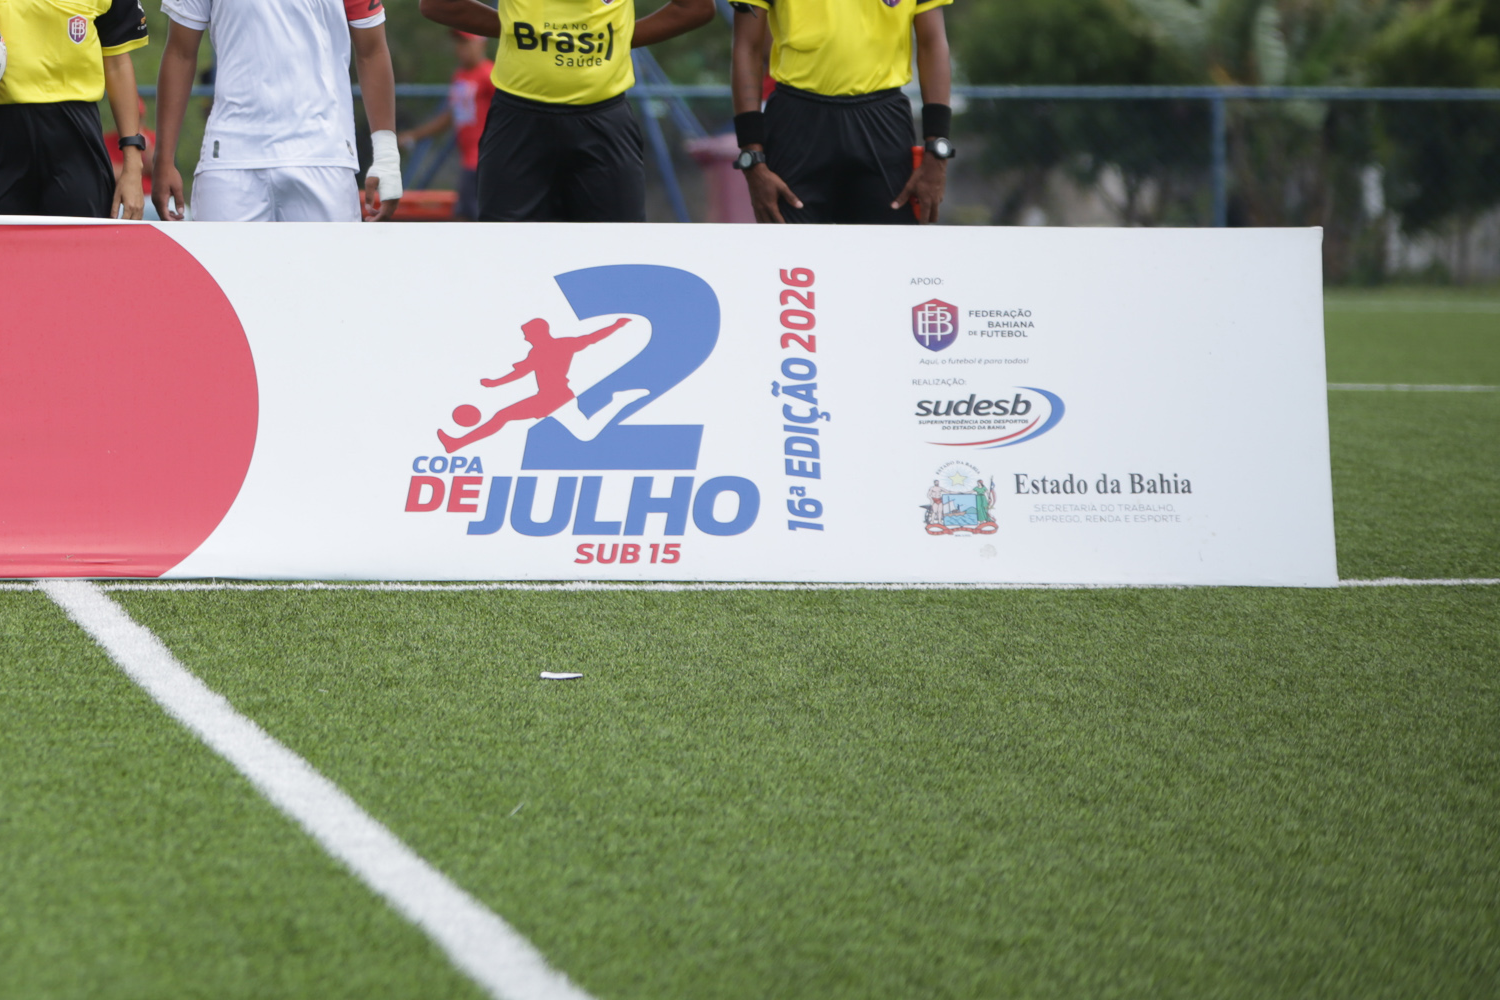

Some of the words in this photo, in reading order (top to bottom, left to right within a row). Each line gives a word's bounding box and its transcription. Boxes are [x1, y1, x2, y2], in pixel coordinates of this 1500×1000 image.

[543, 22, 589, 31] PLANO
[513, 21, 615, 62] Brasil
[554, 54, 603, 68] Saúde
[910, 277, 945, 286] APOIO:
[779, 266, 818, 354] 2026
[968, 308, 1032, 319] FEDERAÇÃO
[987, 321, 1035, 329] BAHIANA
[980, 330, 1029, 338] FUTEBOL
[521, 264, 722, 470] 2
[919, 357, 940, 366] Aqui,
[948, 357, 977, 365] futebol
[984, 358, 1003, 366] para
[1004, 357, 1030, 365] todos!
[912, 378, 968, 387] REALIZAÇÃO:
[914, 393, 1033, 417] sudesb
[771, 356, 831, 481] EDIÇÃO
[412, 455, 485, 475] COPA
[1013, 472, 1089, 495] Estado
[1095, 473, 1122, 495] da
[1128, 472, 1193, 495] Bahia
[404, 475, 484, 513] DE
[466, 475, 761, 537] JULHO
[1033, 503, 1098, 513] SECRETARIA
[1100, 503, 1116, 513] DO
[1117, 503, 1177, 514] TRABALHO,
[1029, 514, 1083, 524] EMPREGO,
[1085, 514, 1122, 523] RENDA
[1124, 514, 1131, 523] E
[1133, 514, 1182, 523] ESPORTE
[574, 543, 642, 565] SUB
[649, 543, 682, 565] 15
